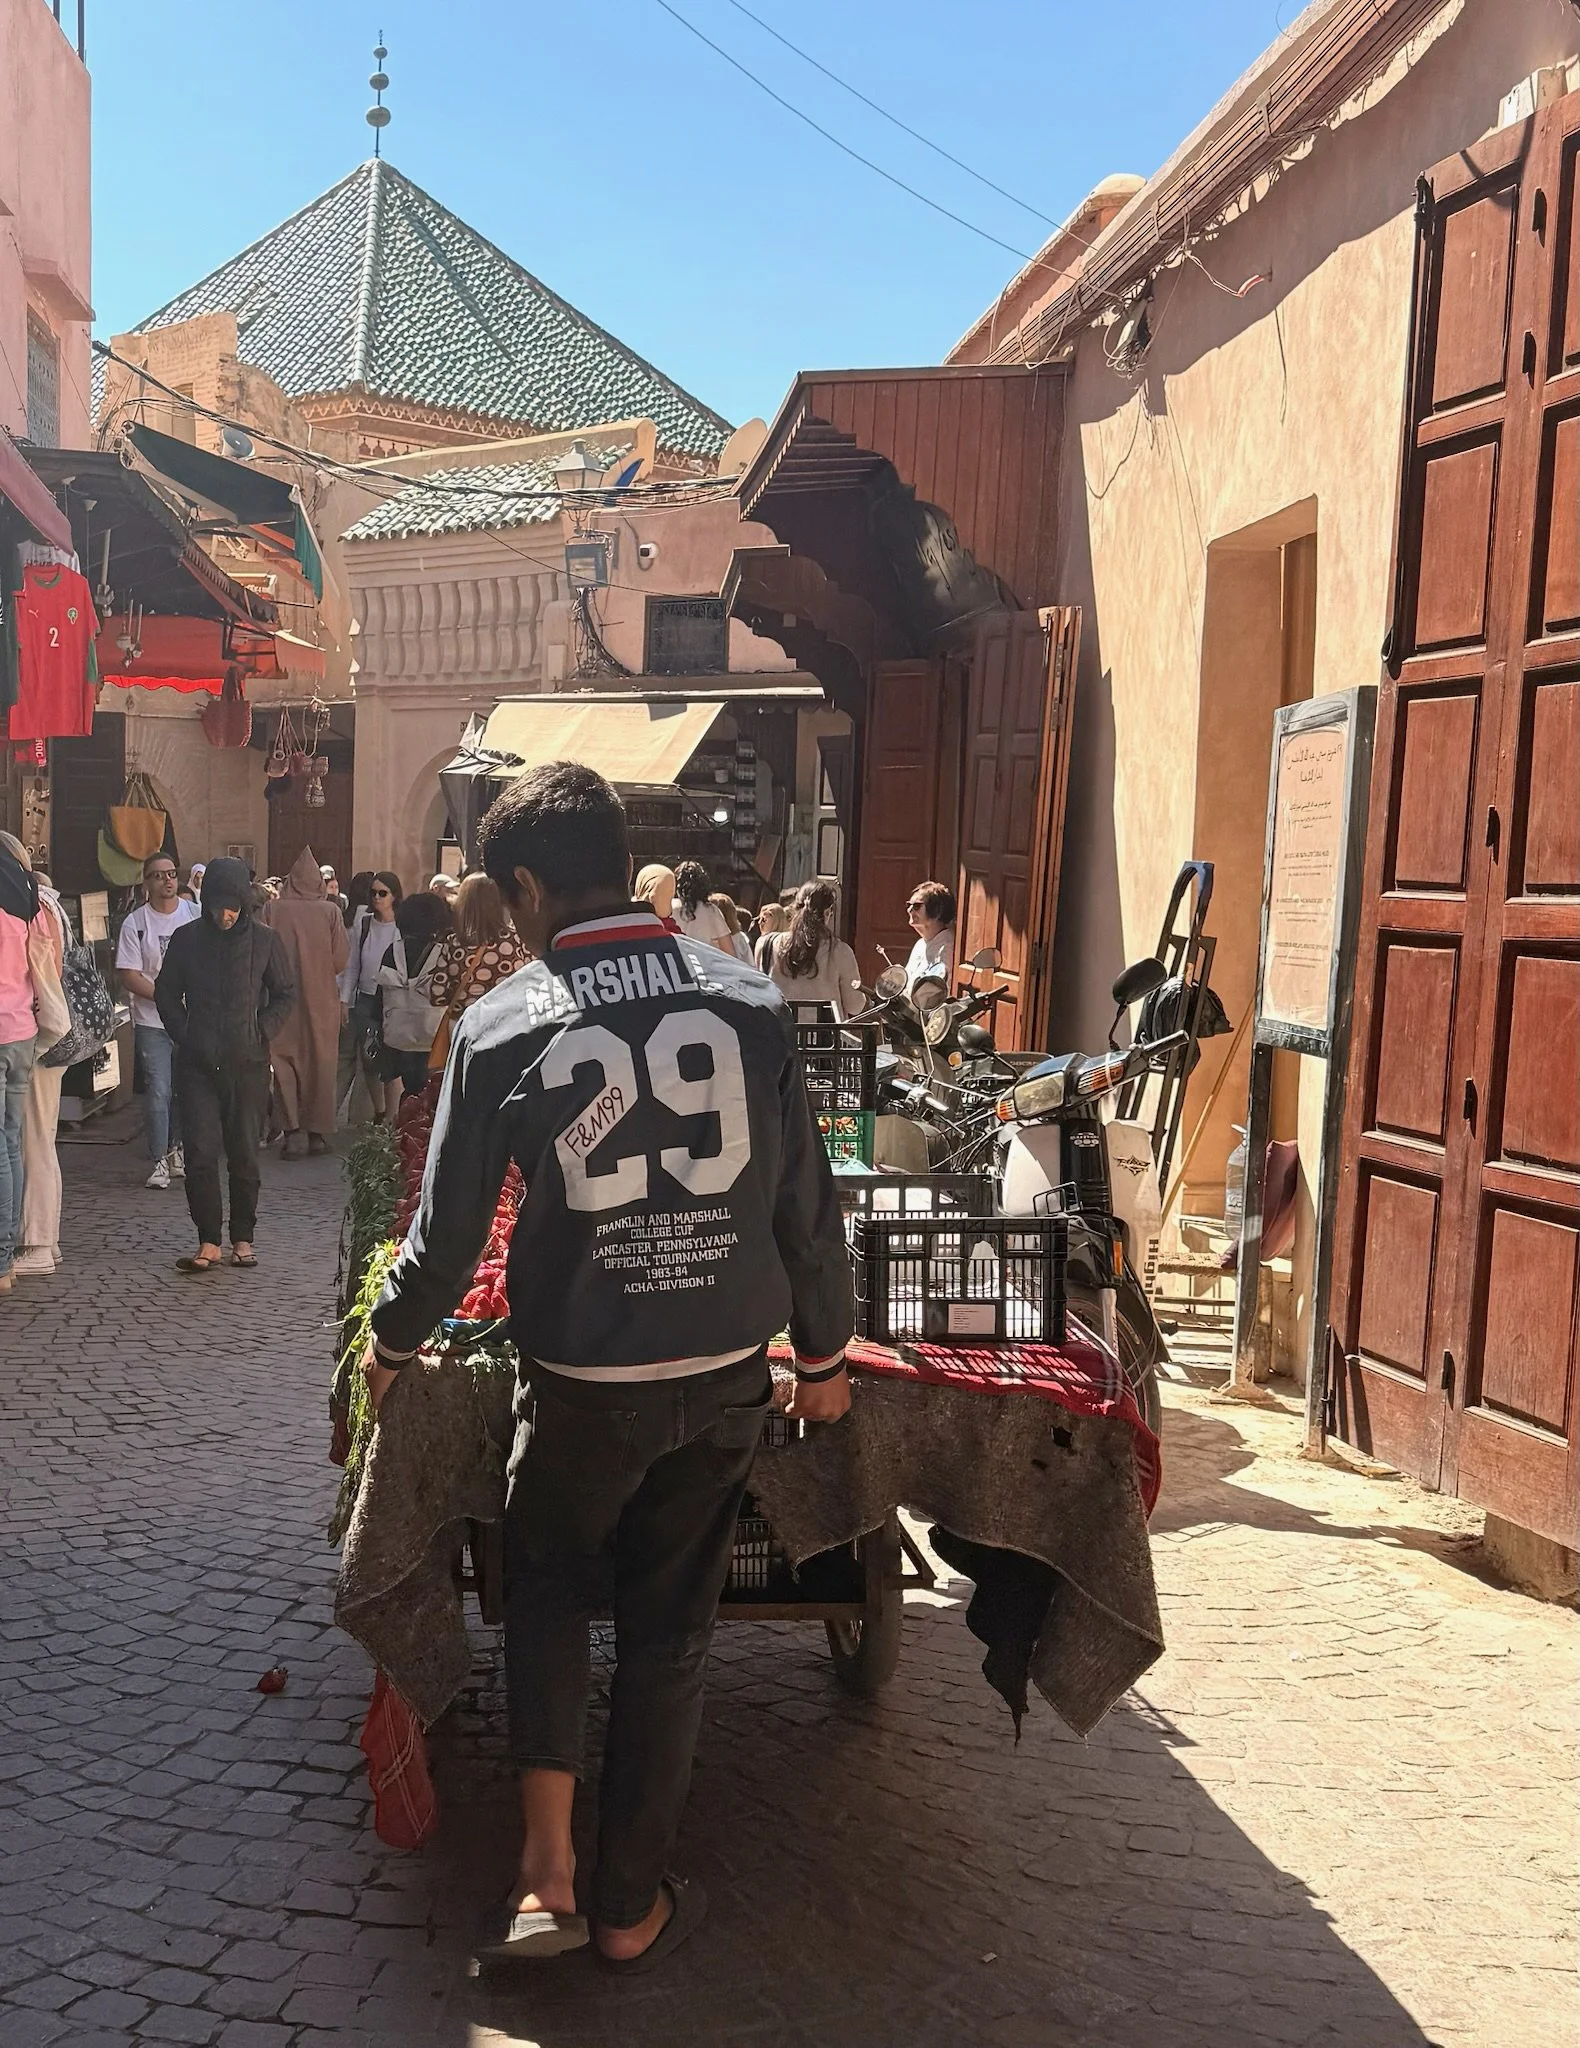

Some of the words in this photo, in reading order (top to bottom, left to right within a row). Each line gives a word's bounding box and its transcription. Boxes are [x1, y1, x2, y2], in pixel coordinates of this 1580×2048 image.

[48, 626, 60, 648] 2
[541, 1008, 751, 1211] 29
[564, 1086, 625, 1158] F&M99
[596, 1215, 645, 1237] FRANKLIN
[648, 1213, 671, 1226] AND
[673, 1208, 731, 1225] MARSHALL
[630, 1226, 673, 1240] COLLEGE
[675, 1224, 694, 1237] CUP
[656, 1233, 738, 1252] PENNSYLVANIA
[604, 1254, 651, 1270] OFFICIAL
[653, 1247, 730, 1266] TOURNAMENT
[623, 1275, 705, 1294] ACHA-DIVISON
